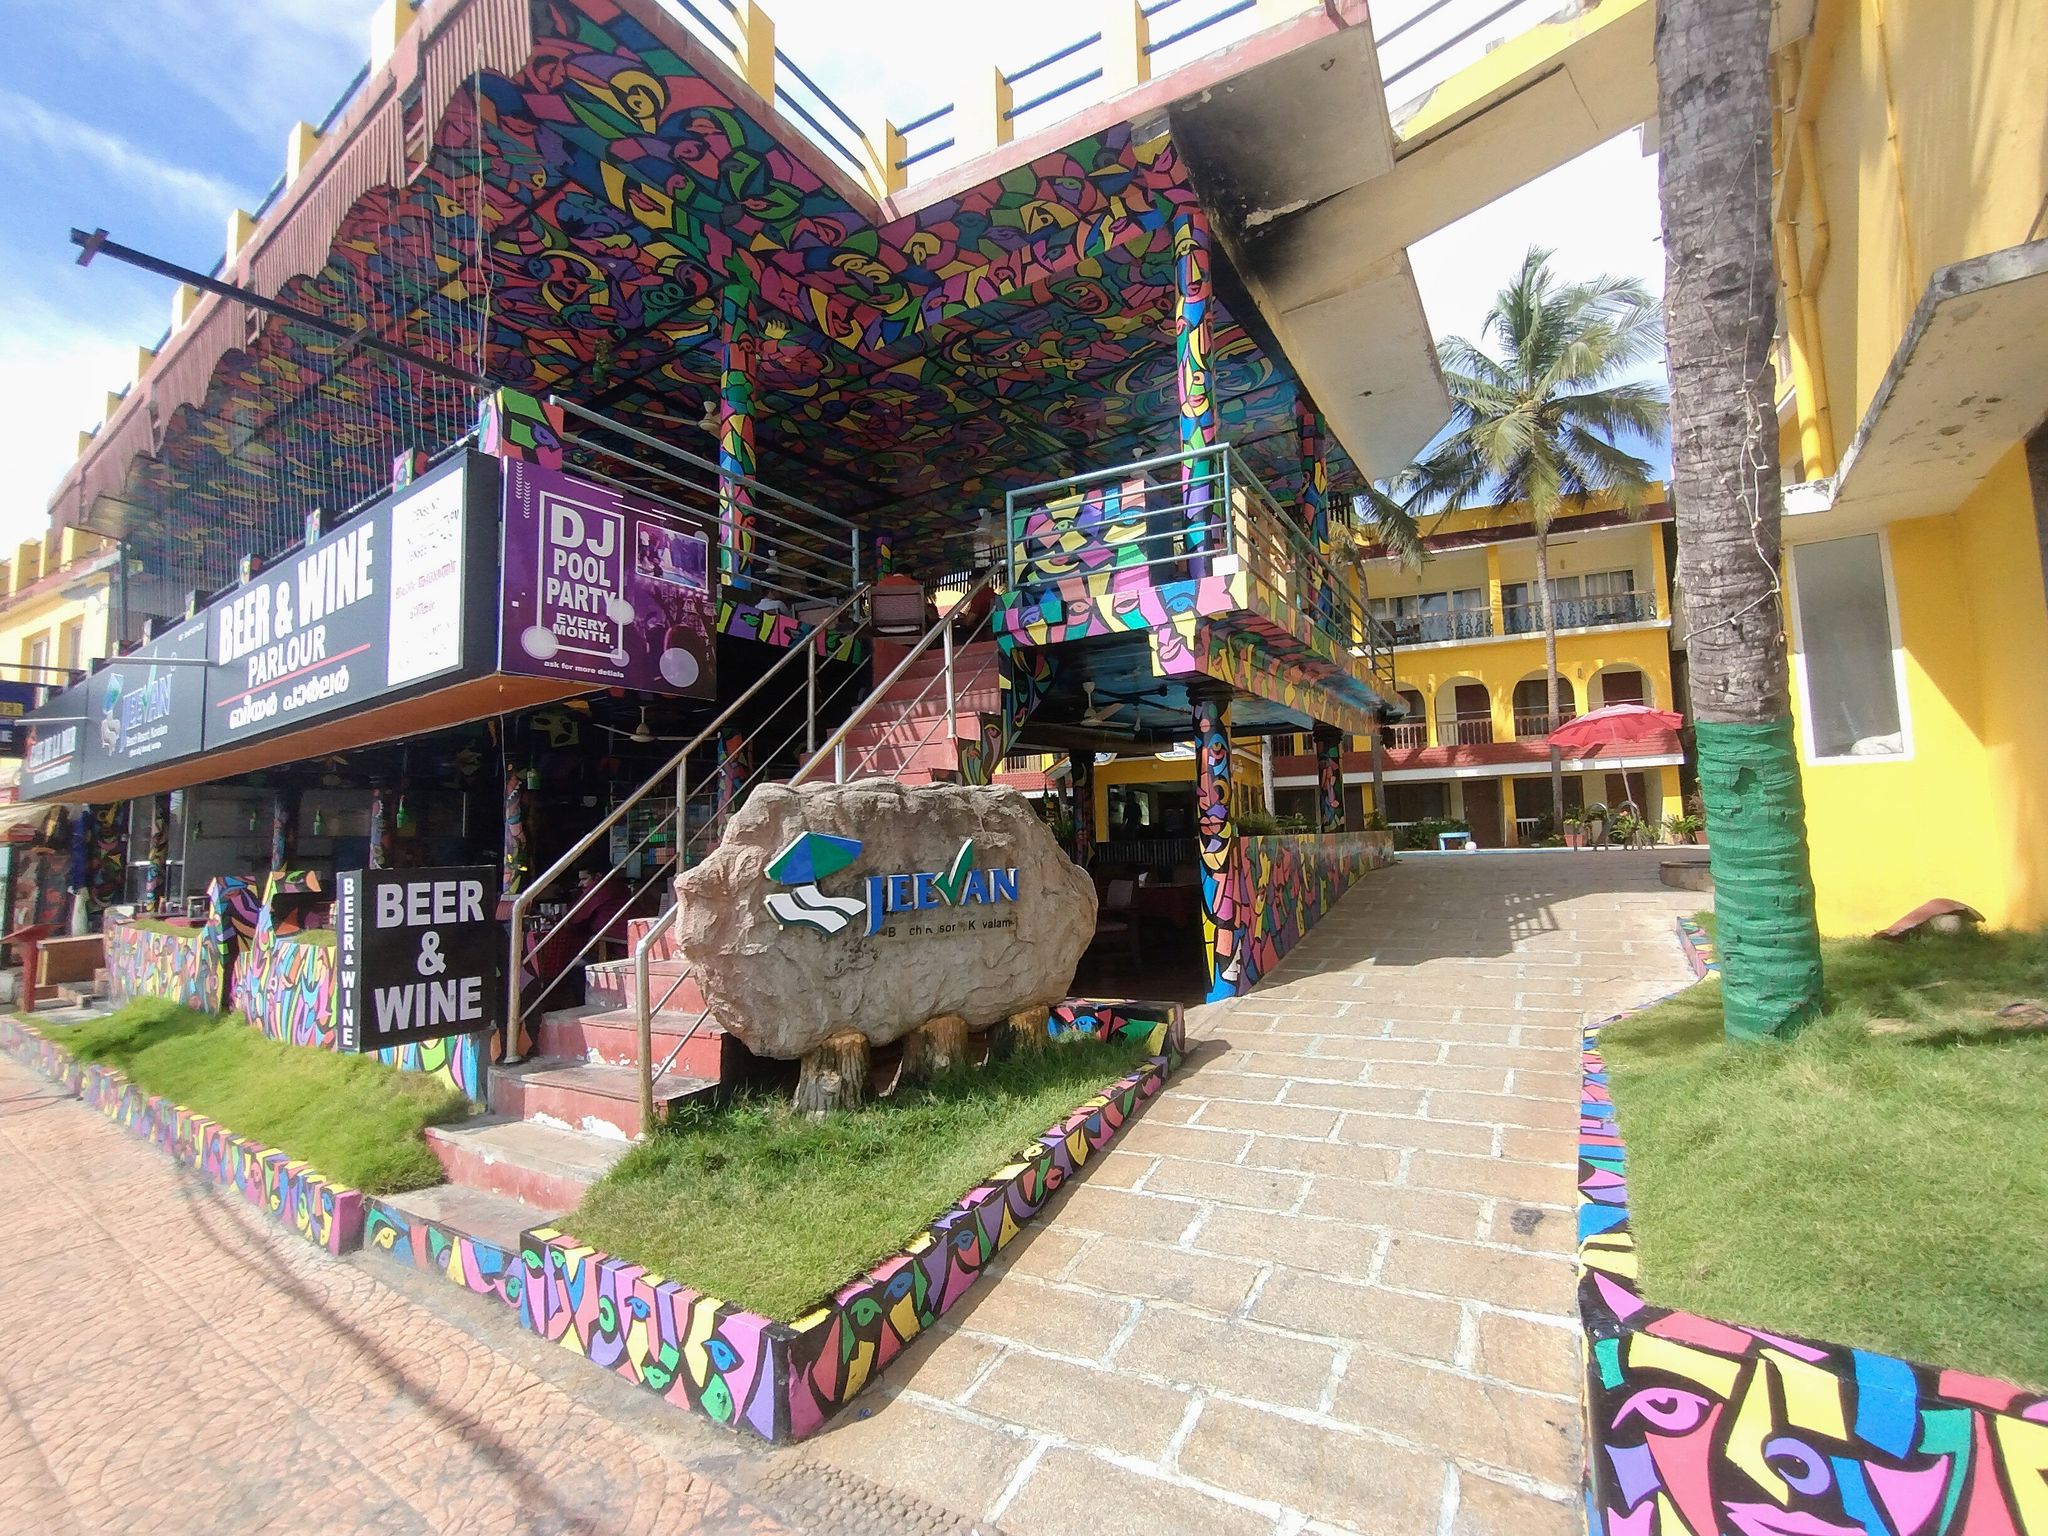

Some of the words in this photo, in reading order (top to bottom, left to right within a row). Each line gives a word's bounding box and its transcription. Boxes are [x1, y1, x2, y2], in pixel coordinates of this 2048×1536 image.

[551, 503, 615, 557] DJ
[553, 548, 611, 587] POOL
[219, 583, 270, 666] BEER
[275, 581, 293, 639] &
[298, 521, 374, 627] WINE
[546, 577, 617, 617] PARTY
[553, 624, 611, 644] MONTH
[556, 612, 608, 632] EVERY
[248, 624, 326, 688] PARLOUR
[575, 665, 596, 674] more
[377, 880, 484, 928] BEER
[864, 838, 1019, 937] JEEVAN
[343, 878, 354, 950] BEER
[888, 925, 922, 938] Bch
[968, 918, 1011, 931] Kvalam
[344, 955, 354, 965] &
[417, 931, 446, 976] &
[341, 971, 355, 1045] WINE
[374, 976, 482, 1032] WINE
